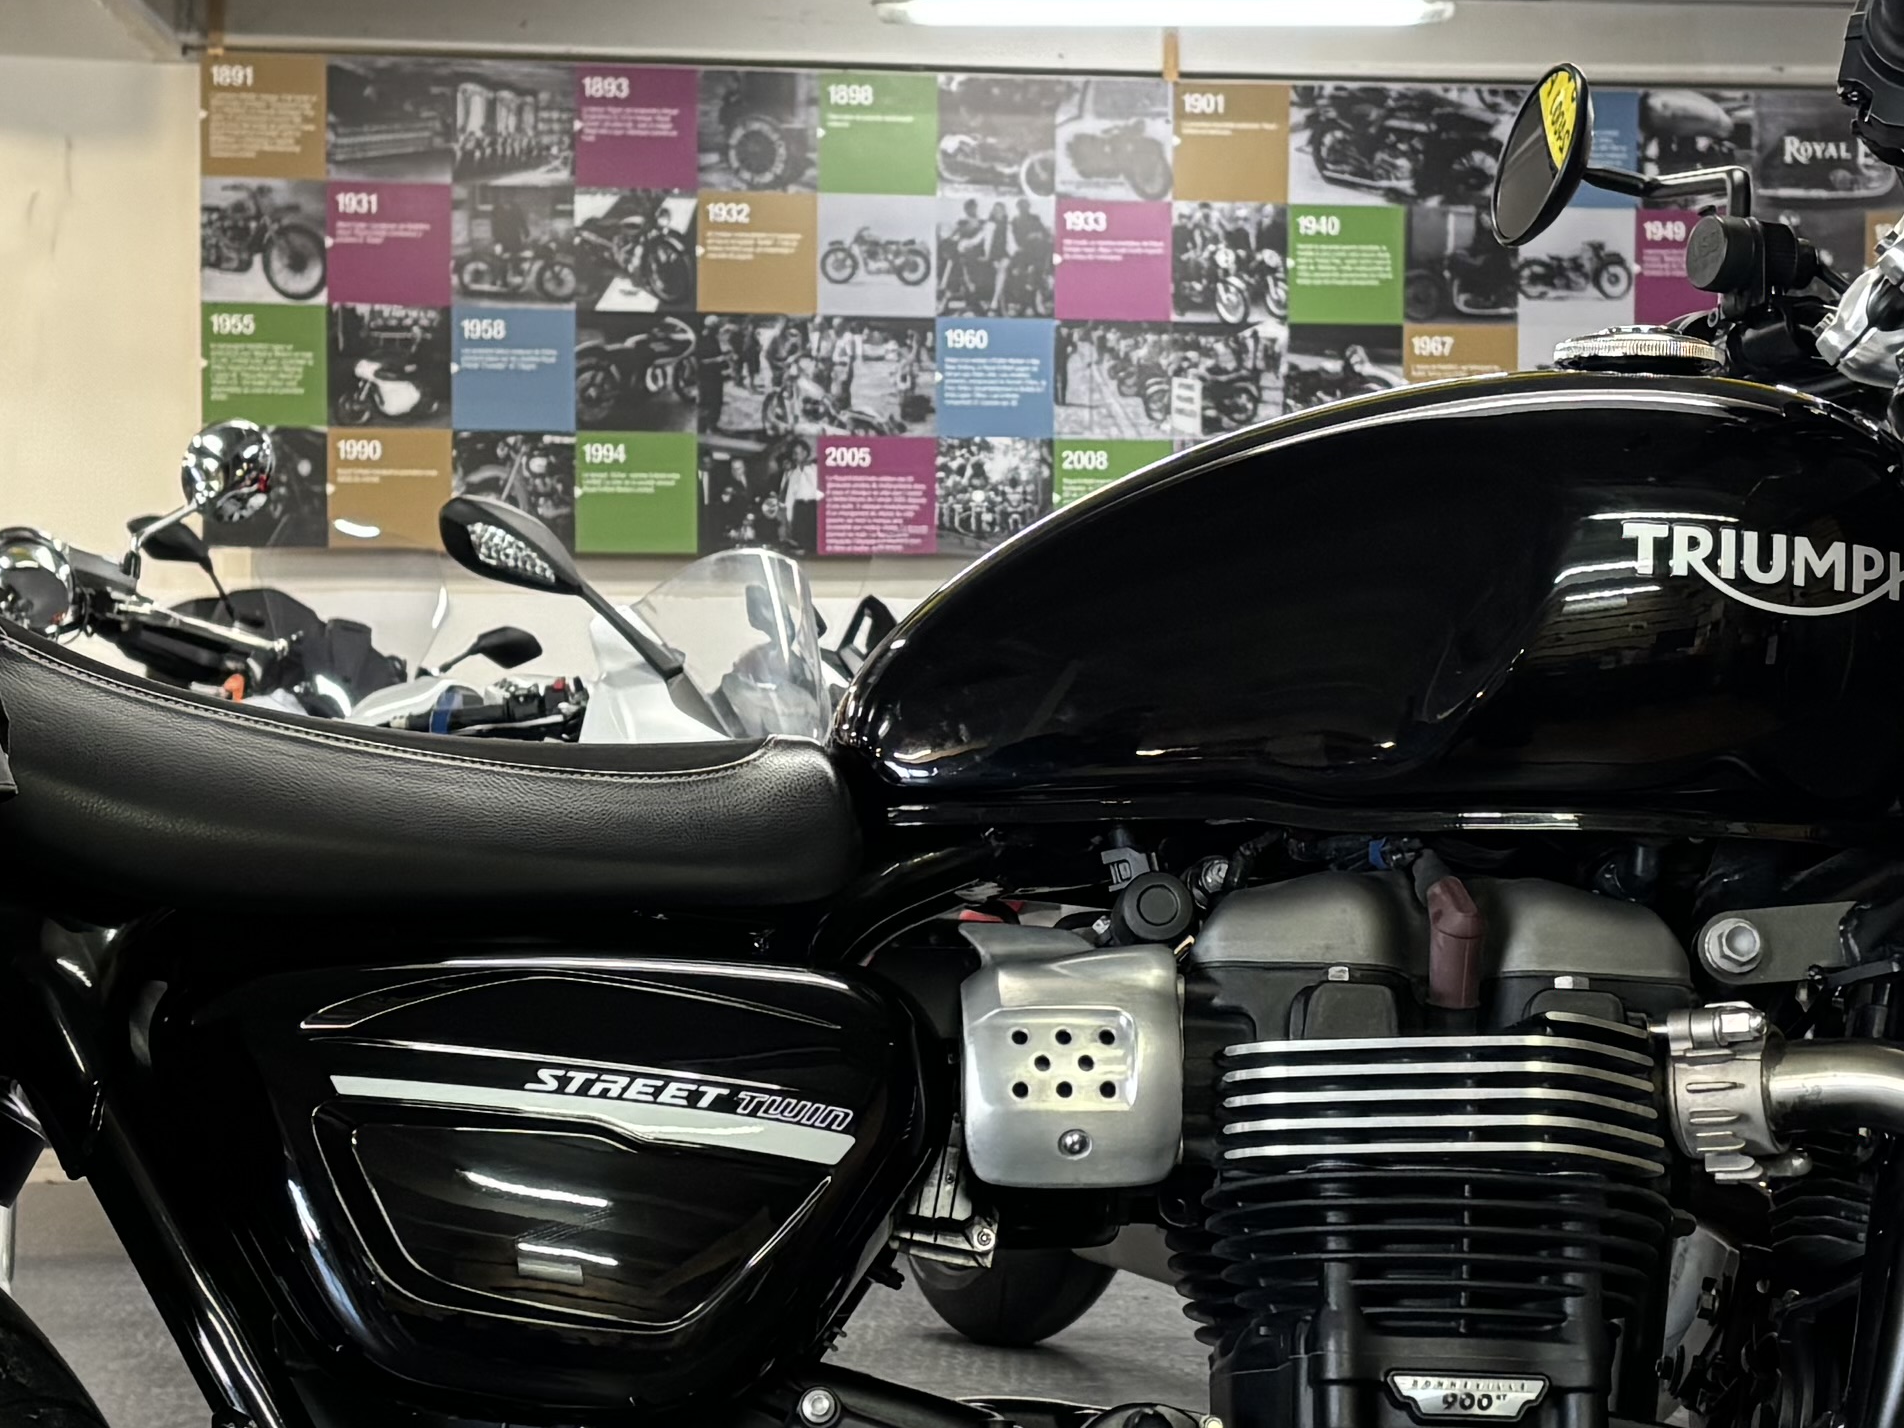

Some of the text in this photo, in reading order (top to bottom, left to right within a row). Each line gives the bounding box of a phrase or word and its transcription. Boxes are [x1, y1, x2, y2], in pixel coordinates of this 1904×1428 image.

[582, 76, 629, 99] 1893
[1182, 93, 1225, 114] 1901
[1784, 136, 1851, 164] ROYAL
[335, 192, 378, 214] 1931
[706, 203, 751, 224] 1932
[1063, 211, 1107, 232] 1933
[1296, 215, 1341, 236] 1940
[1643, 220, 1687, 242] 1949
[210, 313, 256, 335] 1955
[460, 319, 507, 340] 1958
[944, 329, 989, 350] 1960
[1411, 336, 1455, 357] 1967
[337, 440, 382, 461] 1990
[582, 443, 627, 464] 1994
[824, 447, 872, 468] 2005
[1061, 450, 1109, 471] 2008
[524, 1069, 854, 1132] STREET TWIN
[1411, 1379, 1526, 1392] BONNEVILLE
